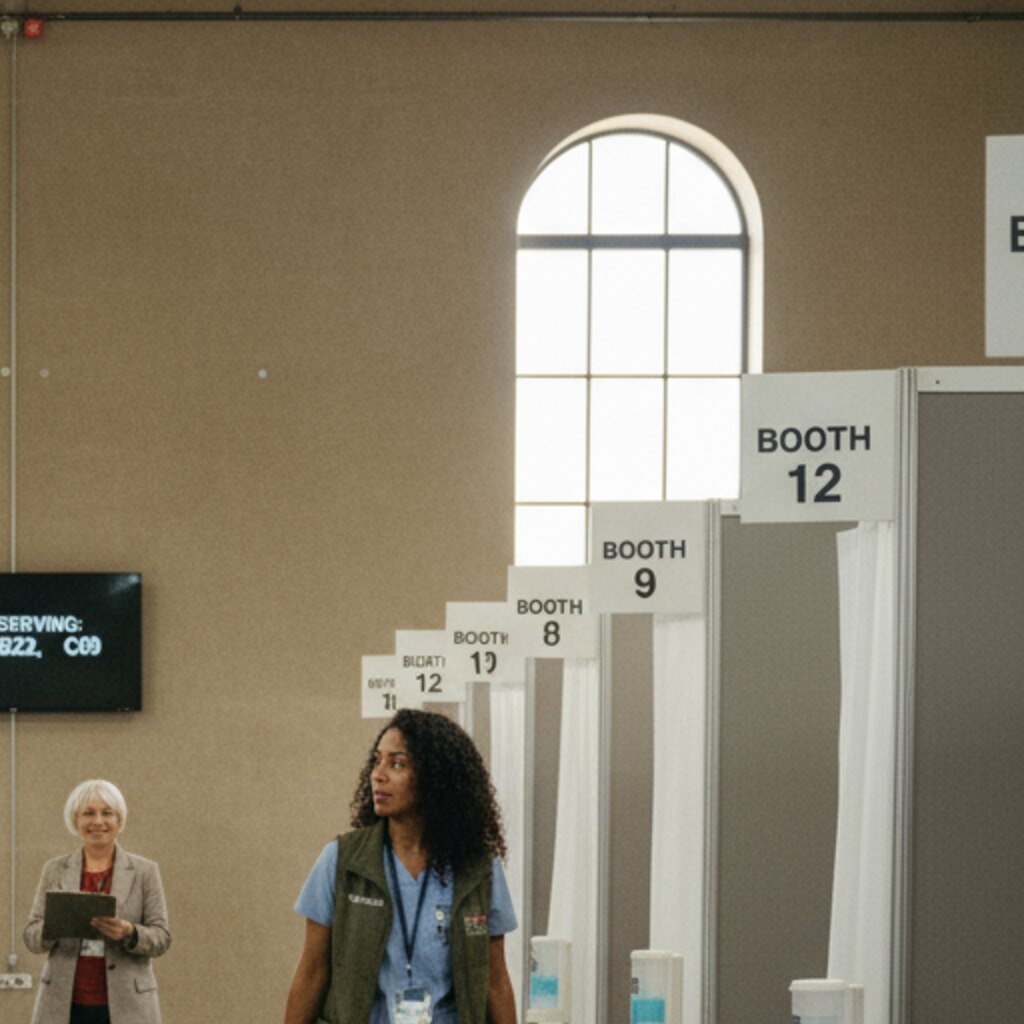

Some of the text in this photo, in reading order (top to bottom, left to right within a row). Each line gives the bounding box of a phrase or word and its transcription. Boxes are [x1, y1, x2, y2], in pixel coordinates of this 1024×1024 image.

[757, 425, 871, 453] BOOTH
[788, 462, 842, 504] 12
[603, 539, 686, 560] BOOTH
[634, 567, 657, 599] 9
[516, 598, 583, 615] BOOTH
[543, 620, 561, 647] 8
[415, 672, 443, 693] 12
